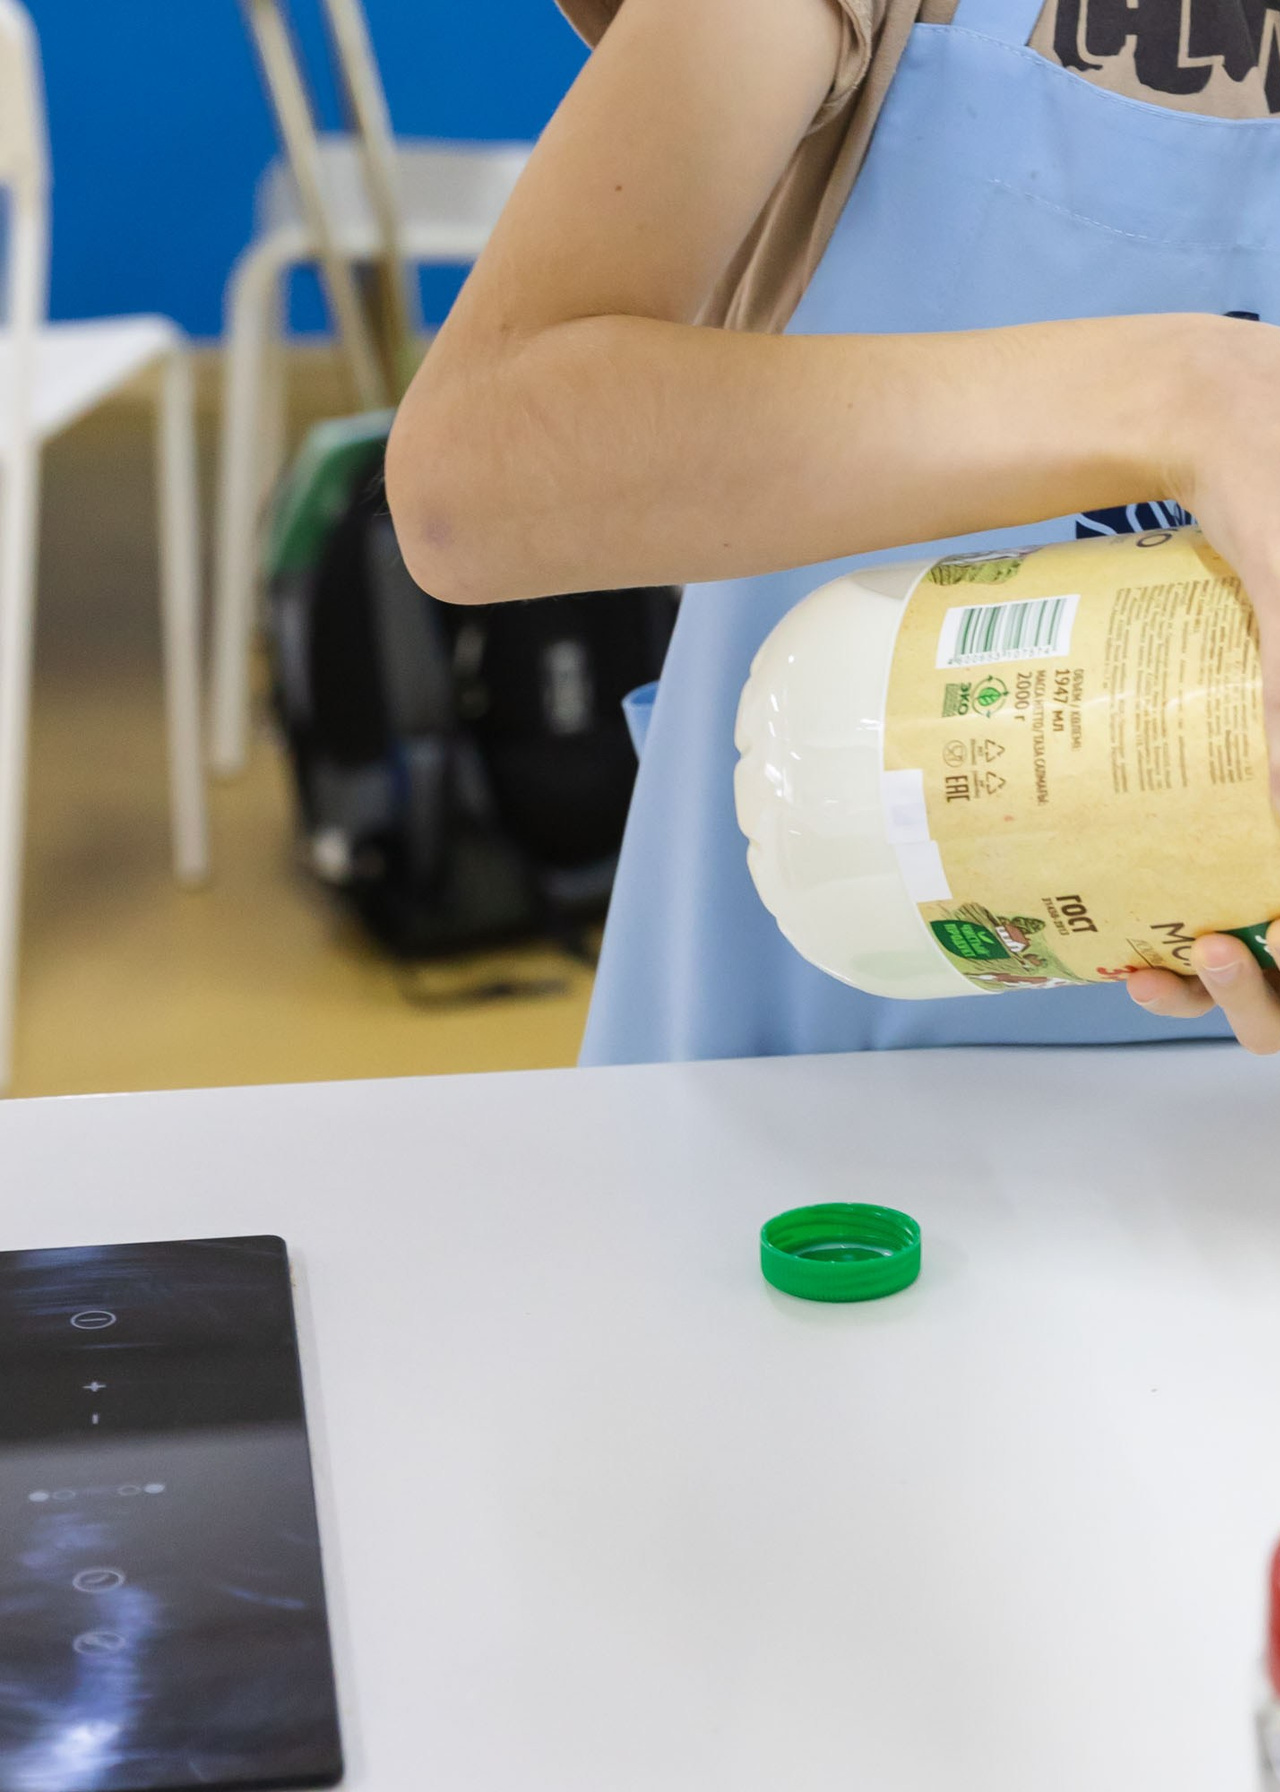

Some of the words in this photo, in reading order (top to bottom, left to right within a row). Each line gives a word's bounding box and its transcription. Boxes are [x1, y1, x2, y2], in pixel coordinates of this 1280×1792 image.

[957, 682, 972, 716] ЭКО
[1014, 671, 1032, 710] 2000
[1054, 669, 1070, 704] 1947
[1056, 895, 1099, 933] ГОСТ
